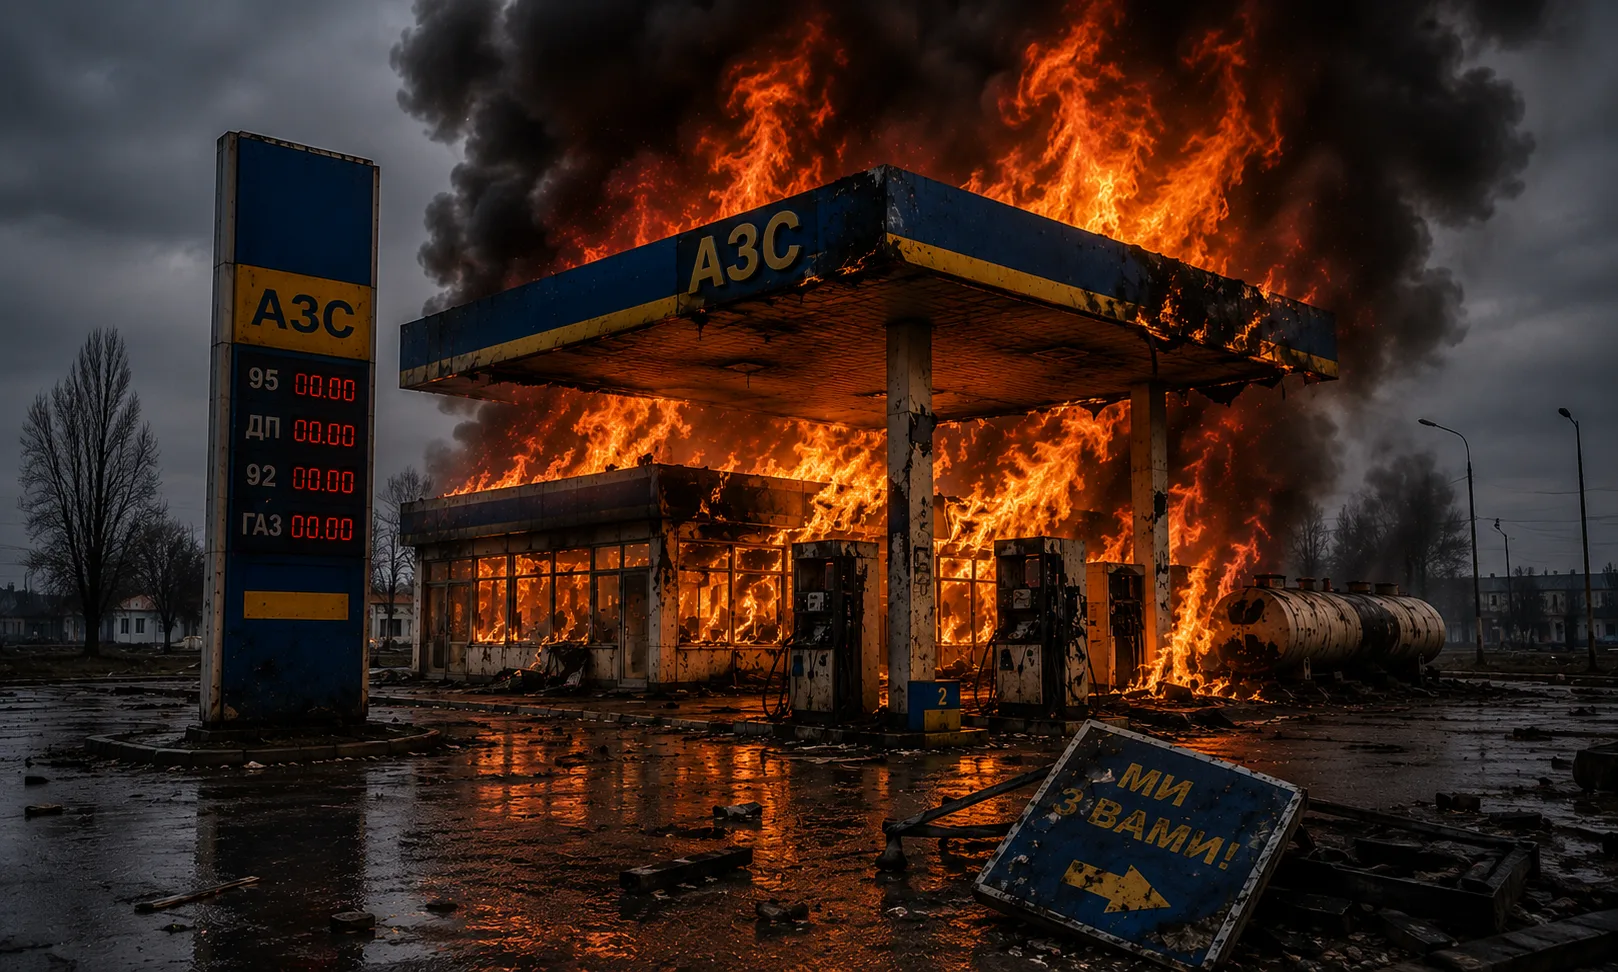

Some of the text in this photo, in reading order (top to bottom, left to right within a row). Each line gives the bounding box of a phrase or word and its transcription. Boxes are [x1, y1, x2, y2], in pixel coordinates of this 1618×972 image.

[688, 210, 801, 295] АЗС
[251, 288, 355, 338] АЗС
[249, 367, 355, 401] 95 00.00
[245, 414, 354, 447] ДП 00.00
[246, 463, 353, 493] 92 00.00
[242, 512, 352, 541] ГАЗ 00.00
[938, 687, 947, 705] 2
[1117, 762, 1194, 807] МИ
[1053, 787, 1240, 870] З ВАМИ!
